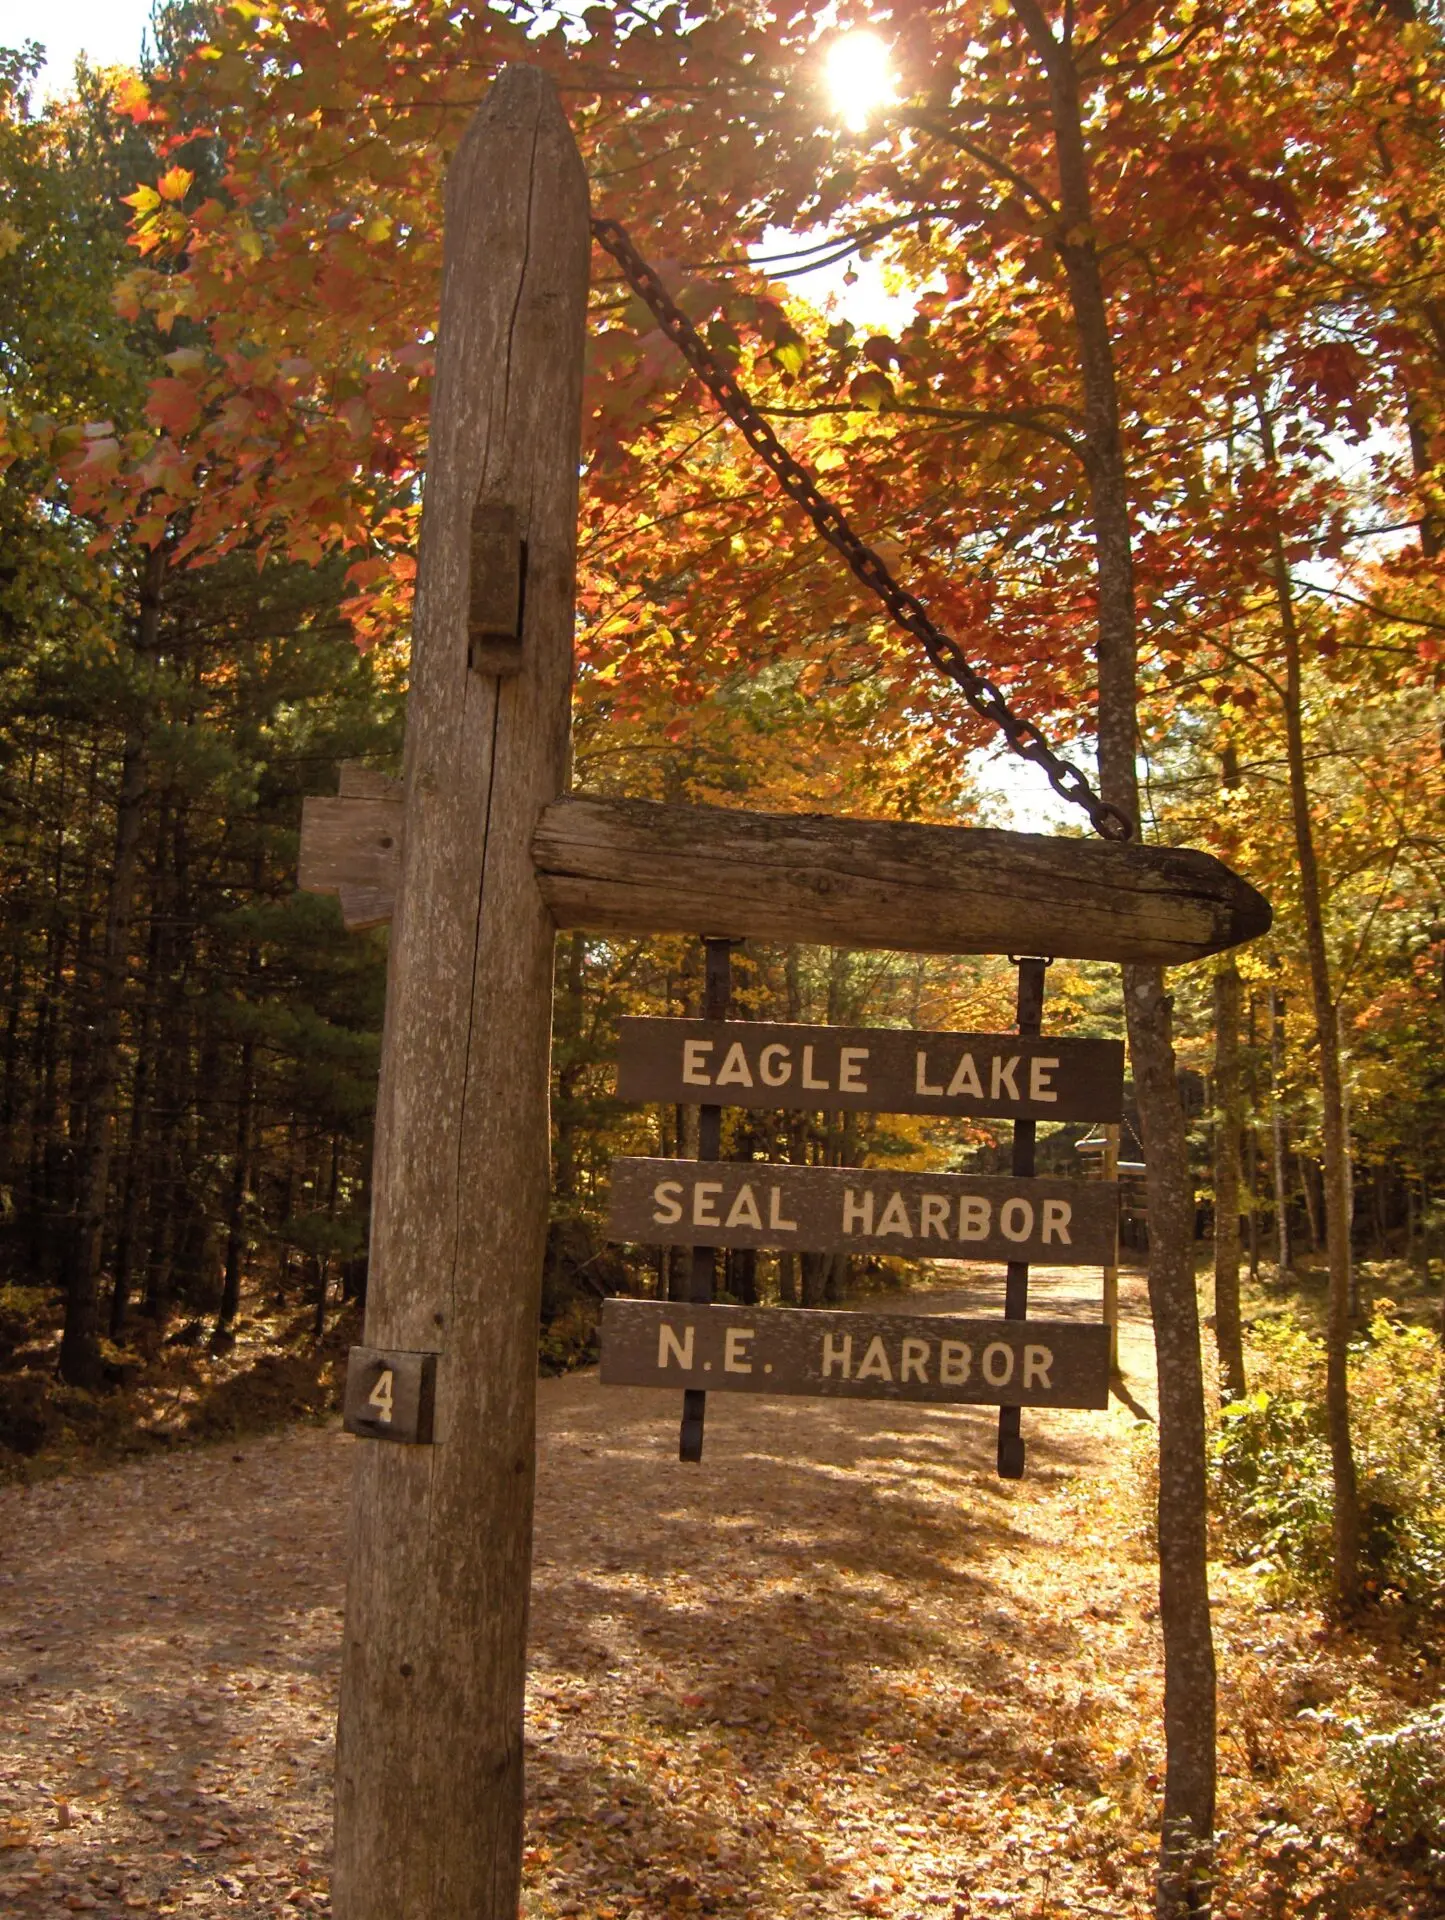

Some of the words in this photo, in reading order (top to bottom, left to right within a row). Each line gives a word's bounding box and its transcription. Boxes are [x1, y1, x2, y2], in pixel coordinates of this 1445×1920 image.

[682, 1039, 870, 1093] EAGLE
[915, 1051, 1060, 1102] LAKE
[653, 1181, 798, 1232] SEAL
[842, 1189, 1074, 1246] HARBOR
[657, 1323, 773, 1374] N.E.
[822, 1333, 1054, 1389] HARBOR
[368, 1370, 393, 1423] 4
